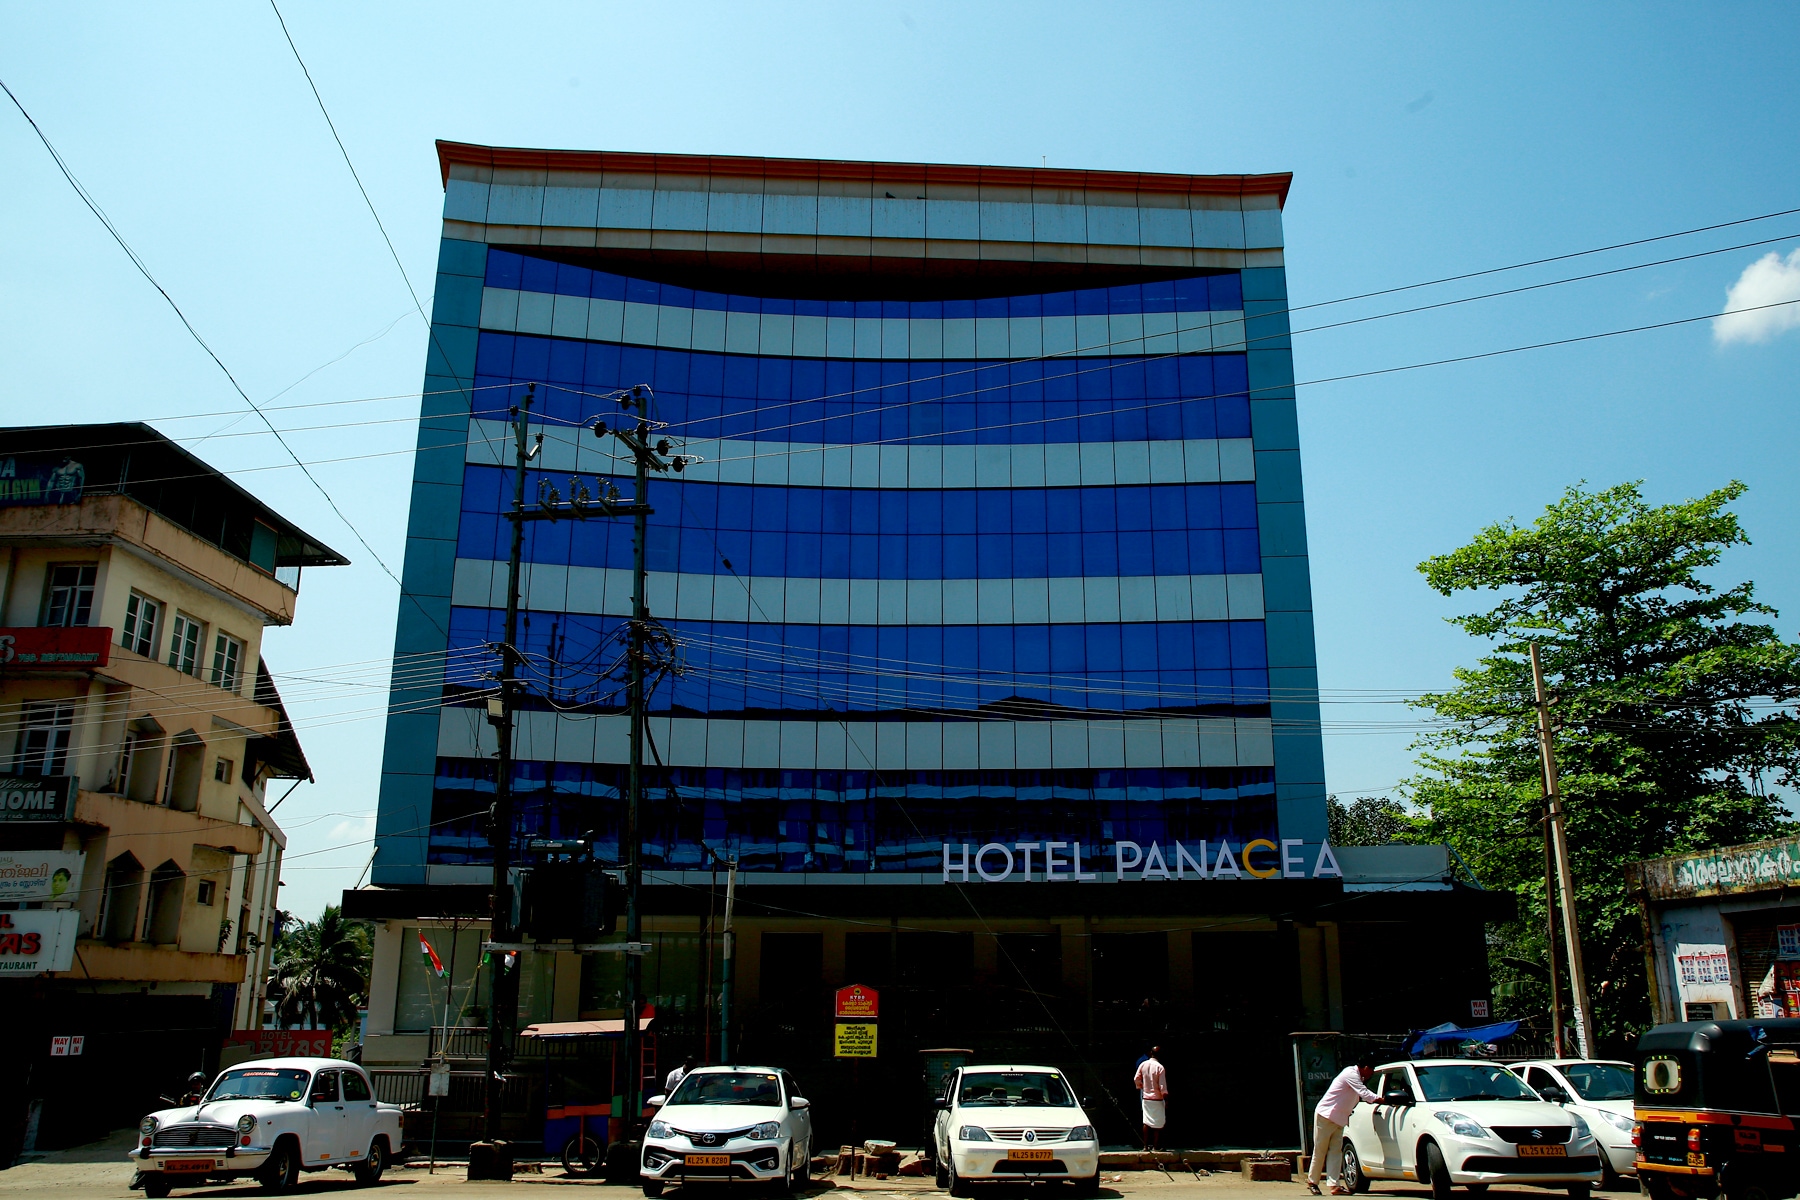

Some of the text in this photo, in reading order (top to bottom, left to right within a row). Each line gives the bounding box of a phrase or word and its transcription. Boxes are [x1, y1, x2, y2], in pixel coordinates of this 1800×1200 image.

[39, 652, 100, 662] RESTAURANT
[943, 838, 1343, 882] HOTEL PANACEA
[1473, 1008, 1487, 1016] OUT
[260, 1031, 293, 1040] HOTEL
[54, 1037, 69, 1045] WAY
[56, 1046, 64, 1054] IN
[227, 1039, 326, 1057] ARYAS
[1307, 1071, 1333, 1080] BSNL
[1012, 1151, 1029, 1159] KL25
[1035, 1151, 1051, 1159] 6777
[1520, 1146, 1539, 1155] KL25
[1546, 1146, 1563, 1155] 2232
[687, 1156, 704, 1164] KL25
[711, 1156, 728, 1164] 8280
